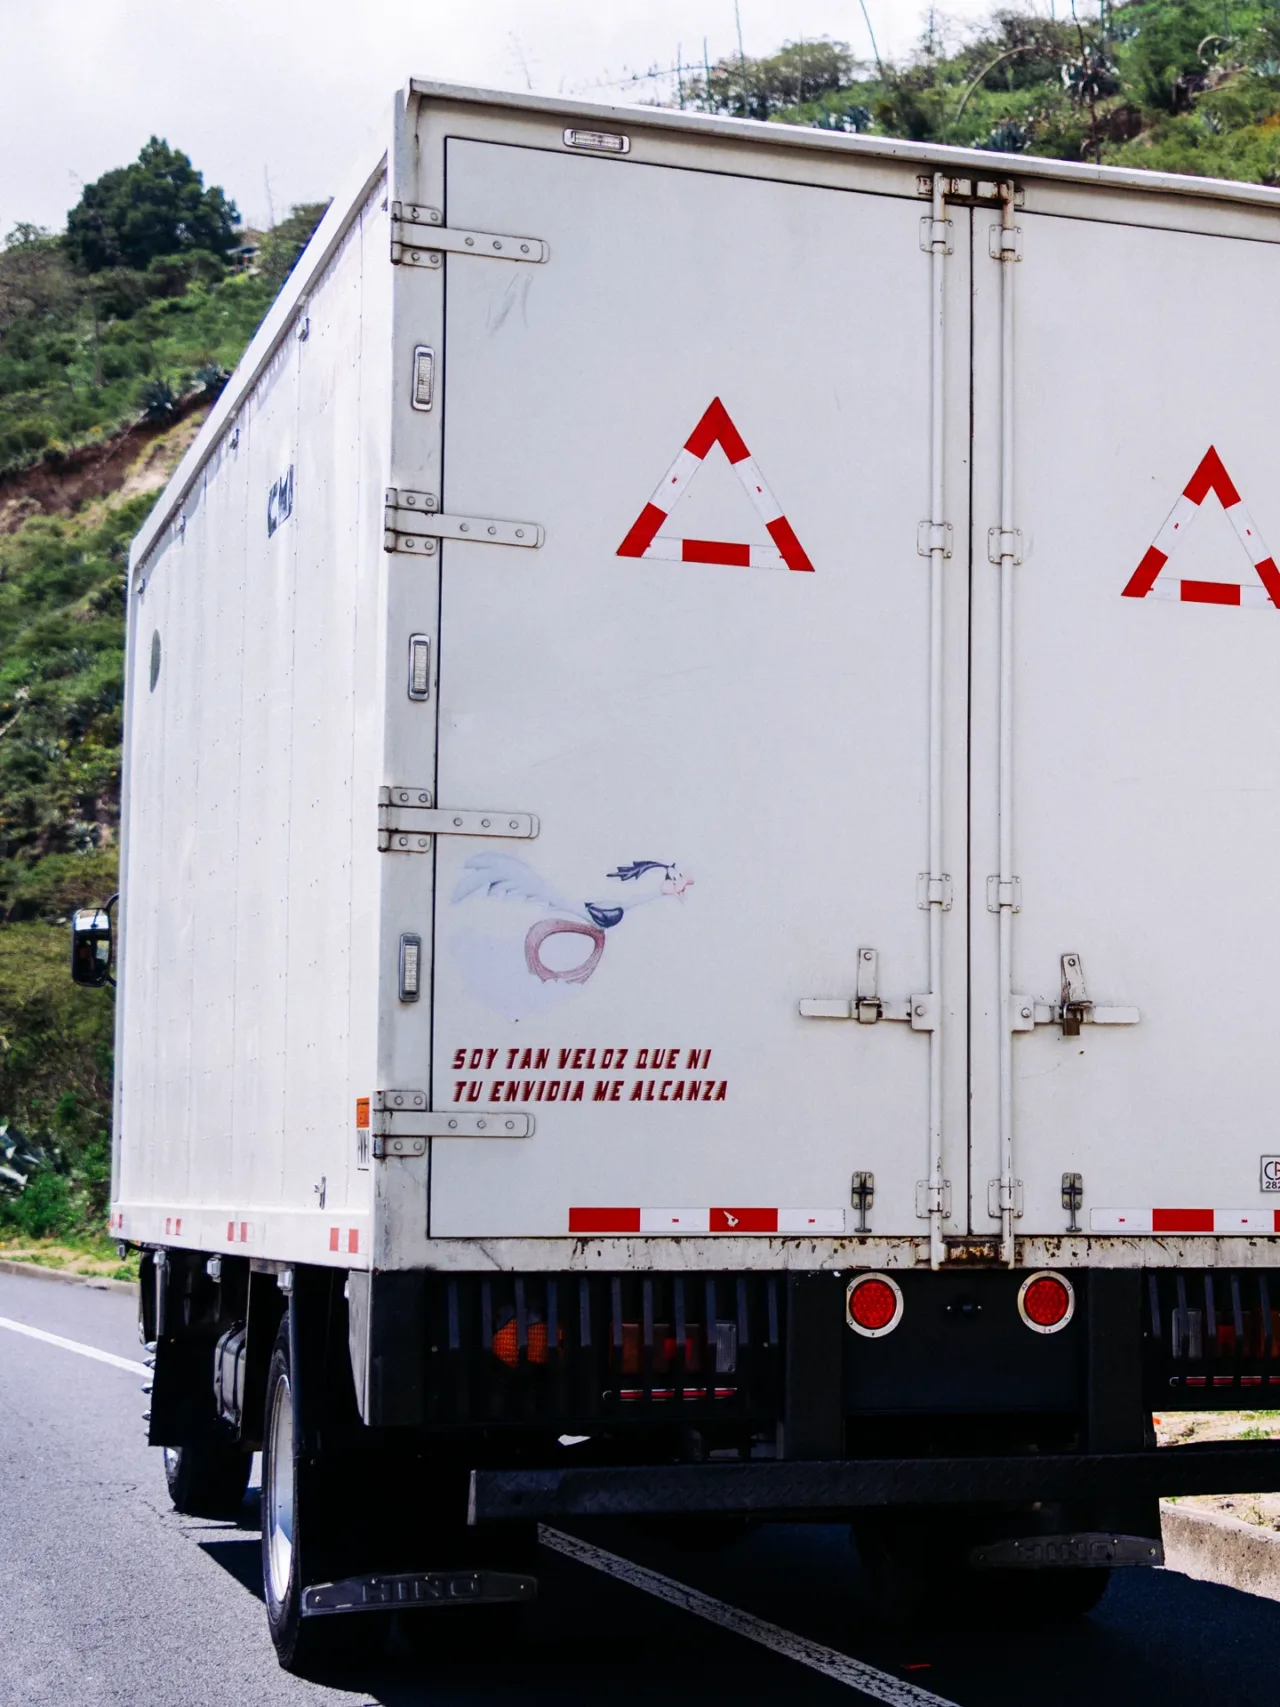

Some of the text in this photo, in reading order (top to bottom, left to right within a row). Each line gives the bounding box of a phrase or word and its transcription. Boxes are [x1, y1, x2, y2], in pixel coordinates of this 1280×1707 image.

[451, 1047, 712, 1070] SOY TAN VELOZ QUE NI
[452, 1080, 728, 1102] TU ENVIDIA ME ALCANZA
[361, 1578, 482, 1603] HINO
